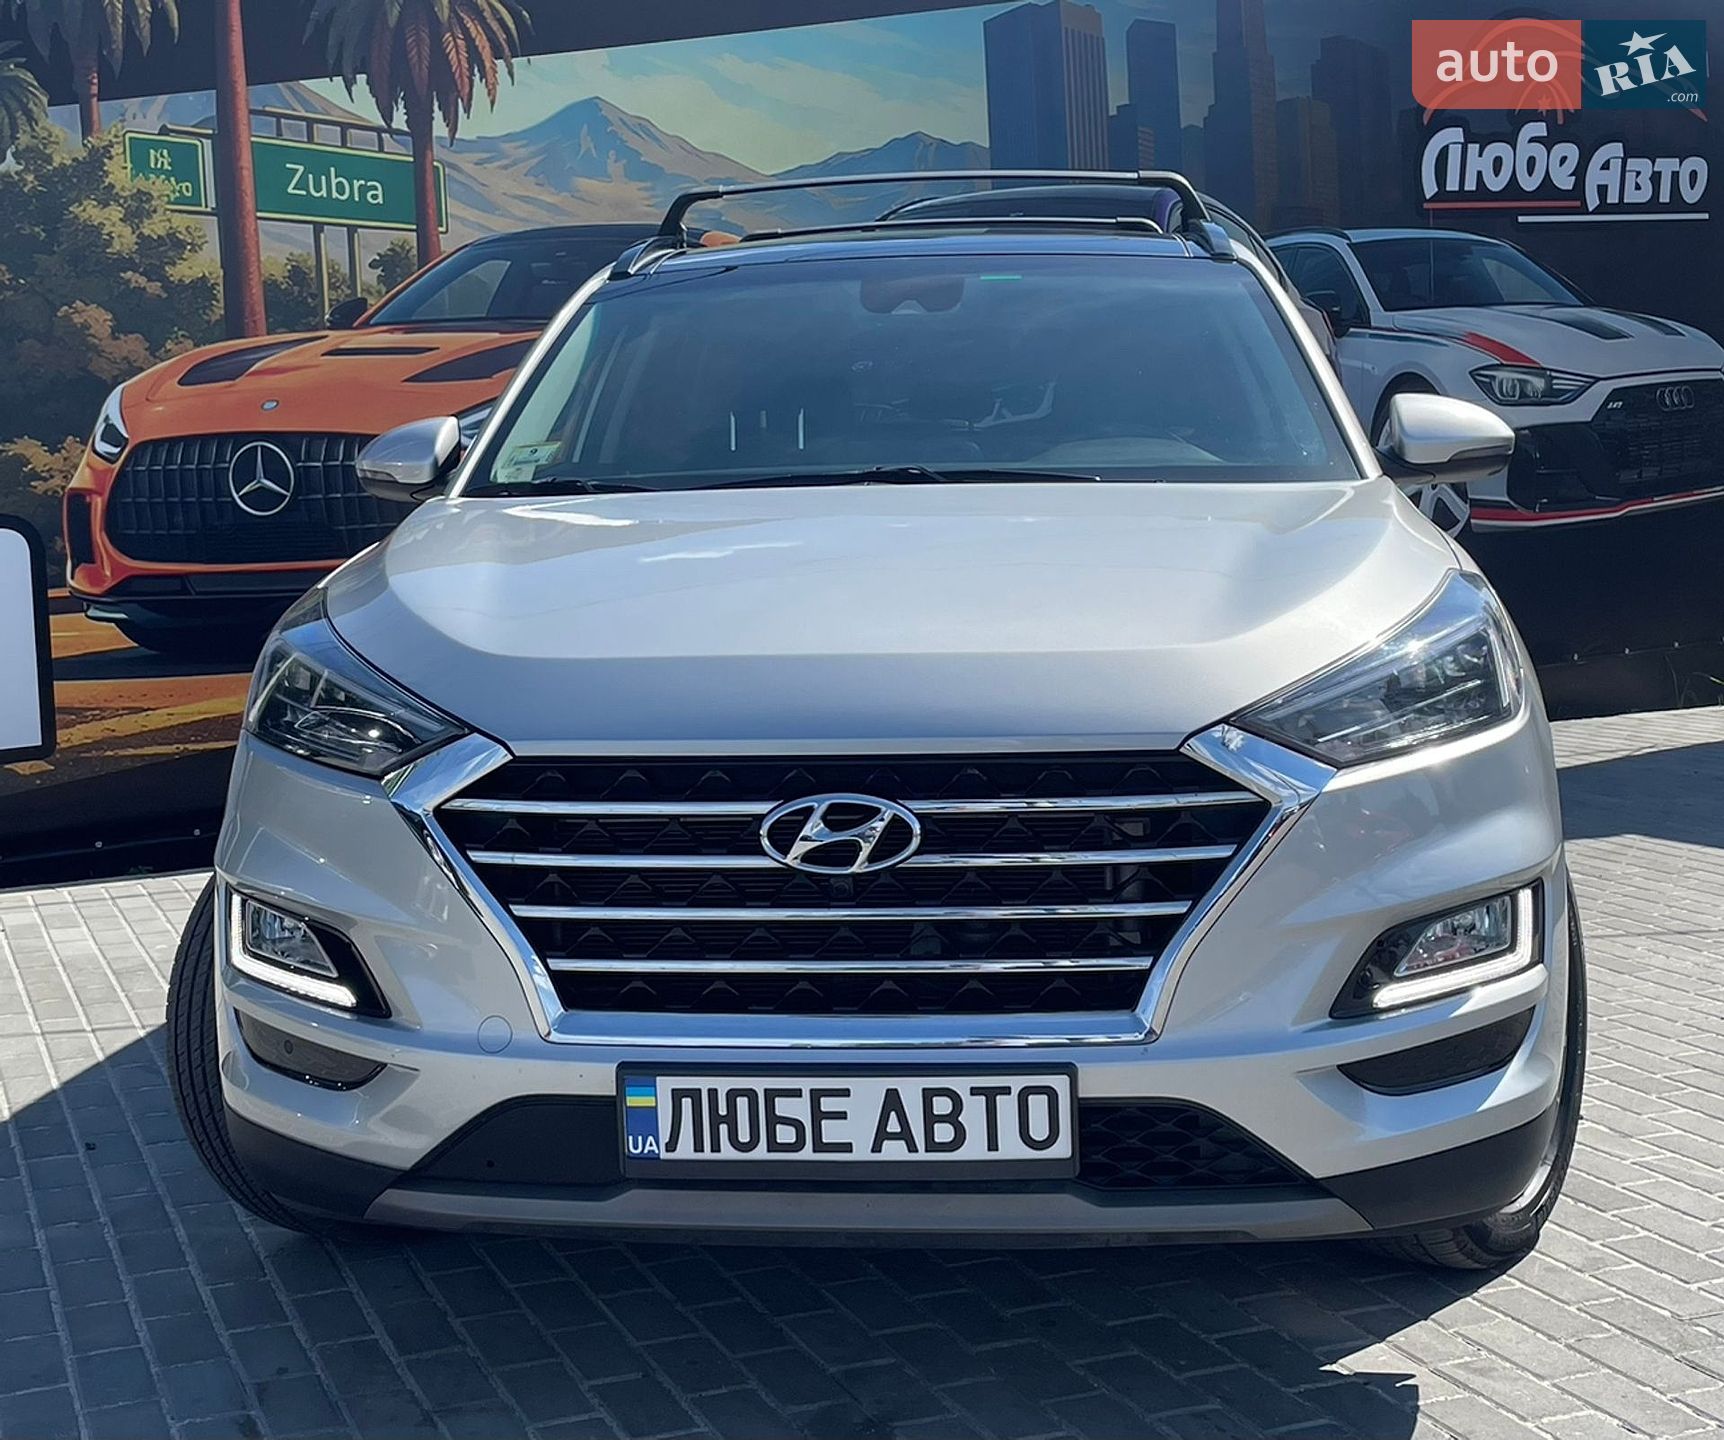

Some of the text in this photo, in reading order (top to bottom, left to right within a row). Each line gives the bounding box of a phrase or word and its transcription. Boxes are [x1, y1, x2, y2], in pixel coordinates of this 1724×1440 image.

[285, 164, 384, 204] Zubra
[1421, 122, 1580, 200] Любе
[628, 1136, 660, 1154] UA
[665, 1086, 1061, 1154] ЛЮБЕ АВТО
